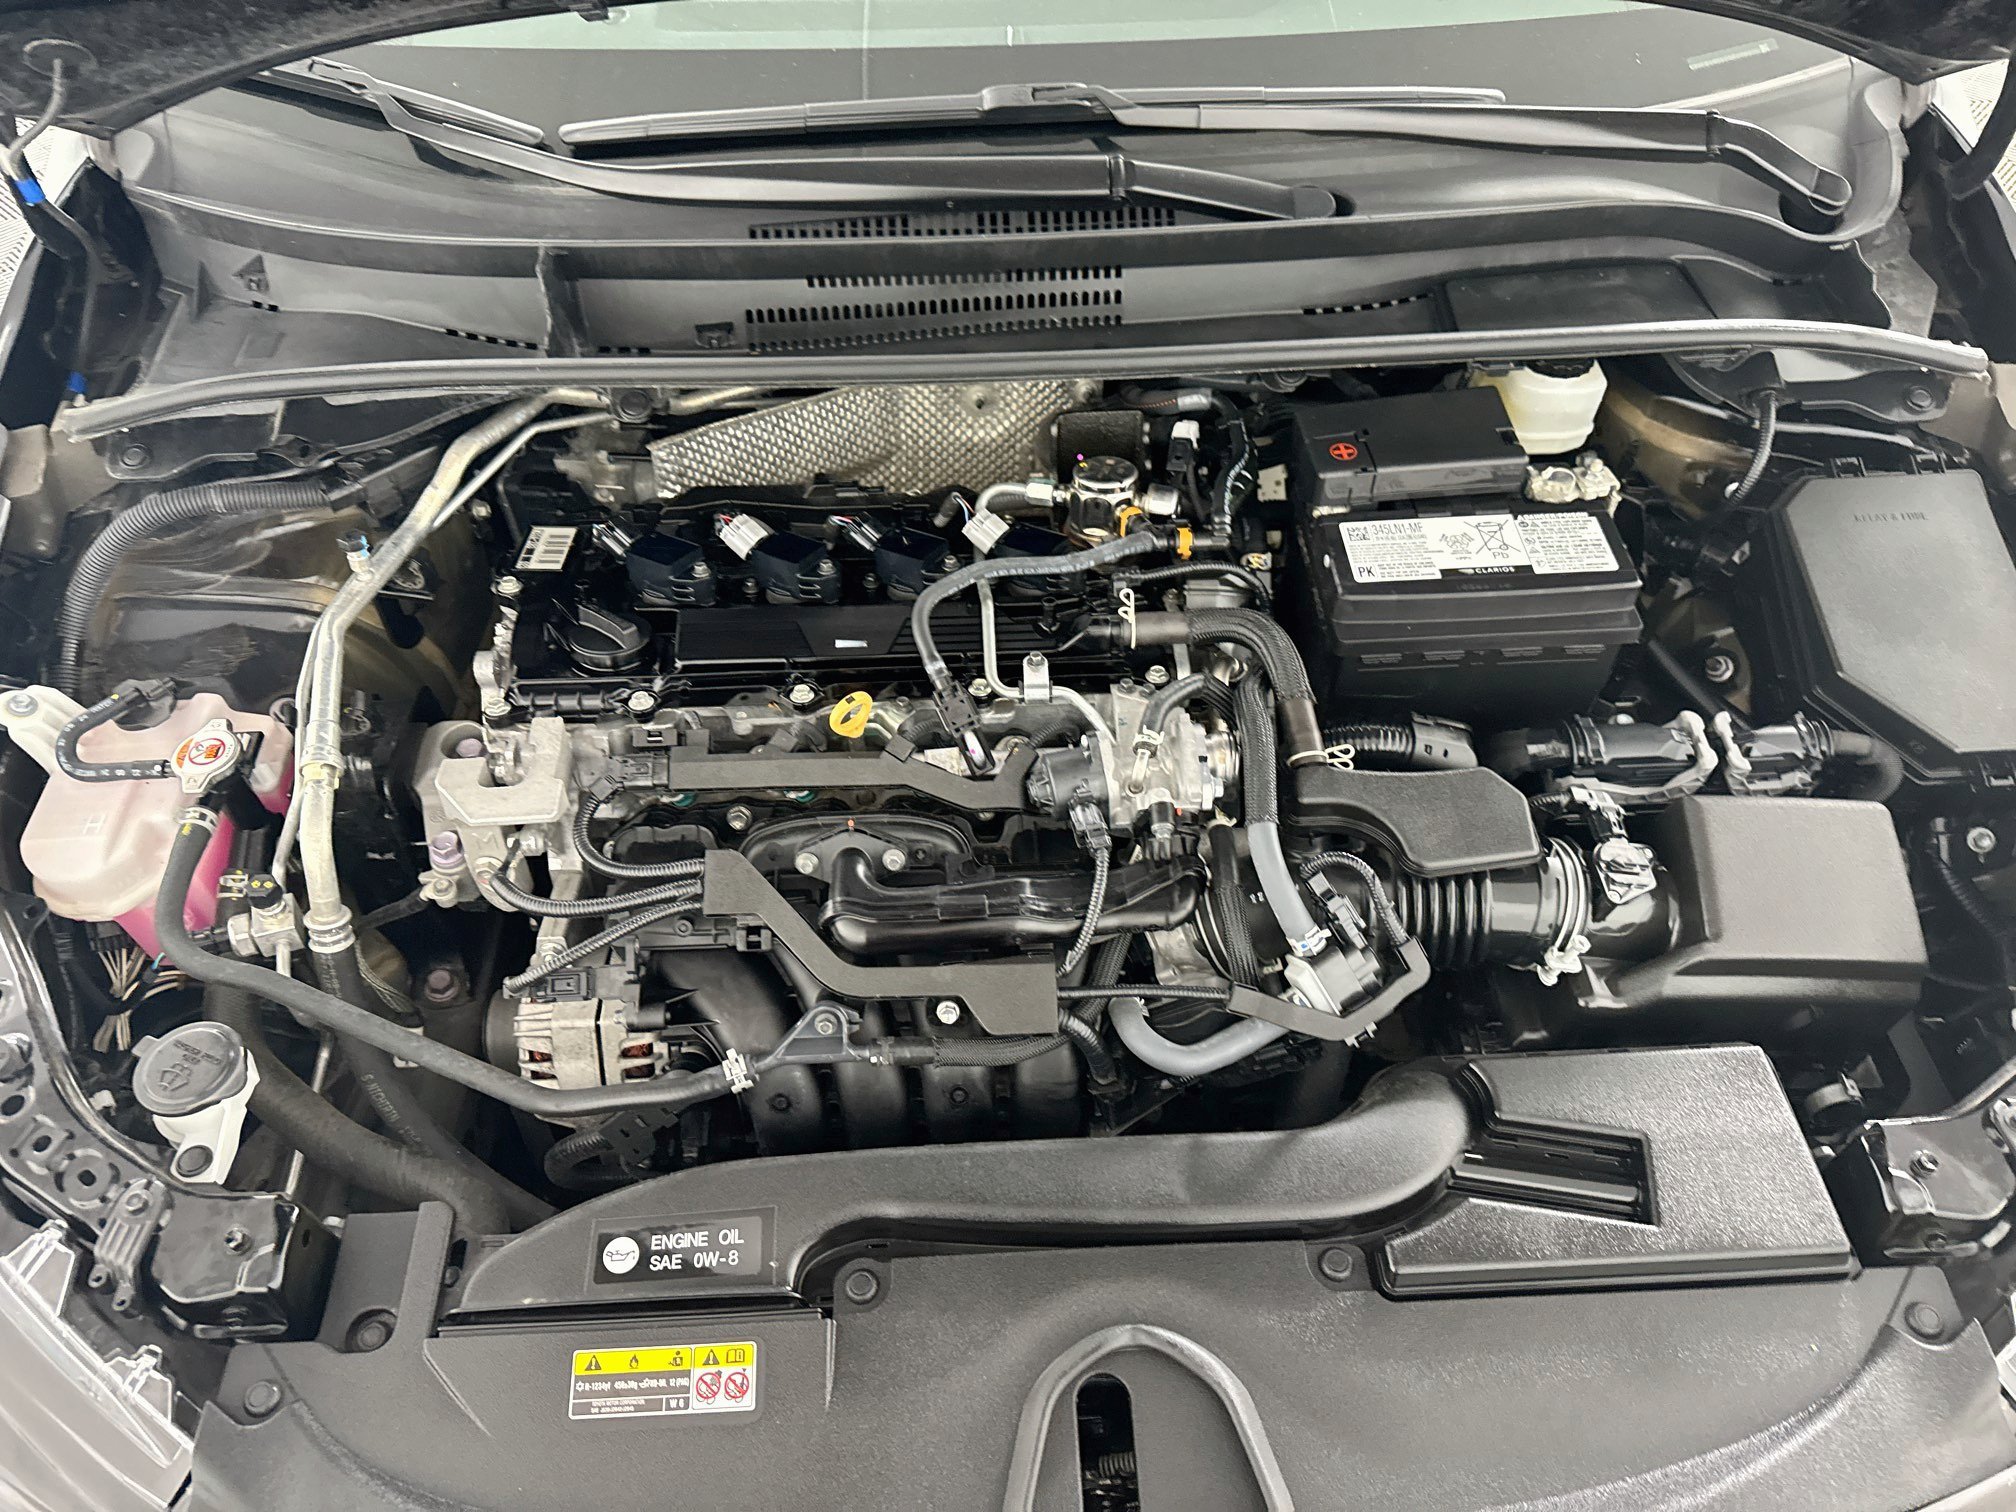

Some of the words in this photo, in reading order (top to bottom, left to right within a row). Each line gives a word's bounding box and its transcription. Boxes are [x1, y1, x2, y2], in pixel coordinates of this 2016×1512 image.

[1371, 522, 1423, 536] 345LN1-MF
[1492, 551, 1510, 560] Pb
[1358, 566, 1375, 577] PK
[1475, 566, 1515, 574] CLARIOS
[651, 1231, 709, 1250] ENGINE
[718, 1228, 745, 1245] OIL
[649, 1253, 683, 1271] SAE
[693, 1250, 739, 1268] 0W-8
